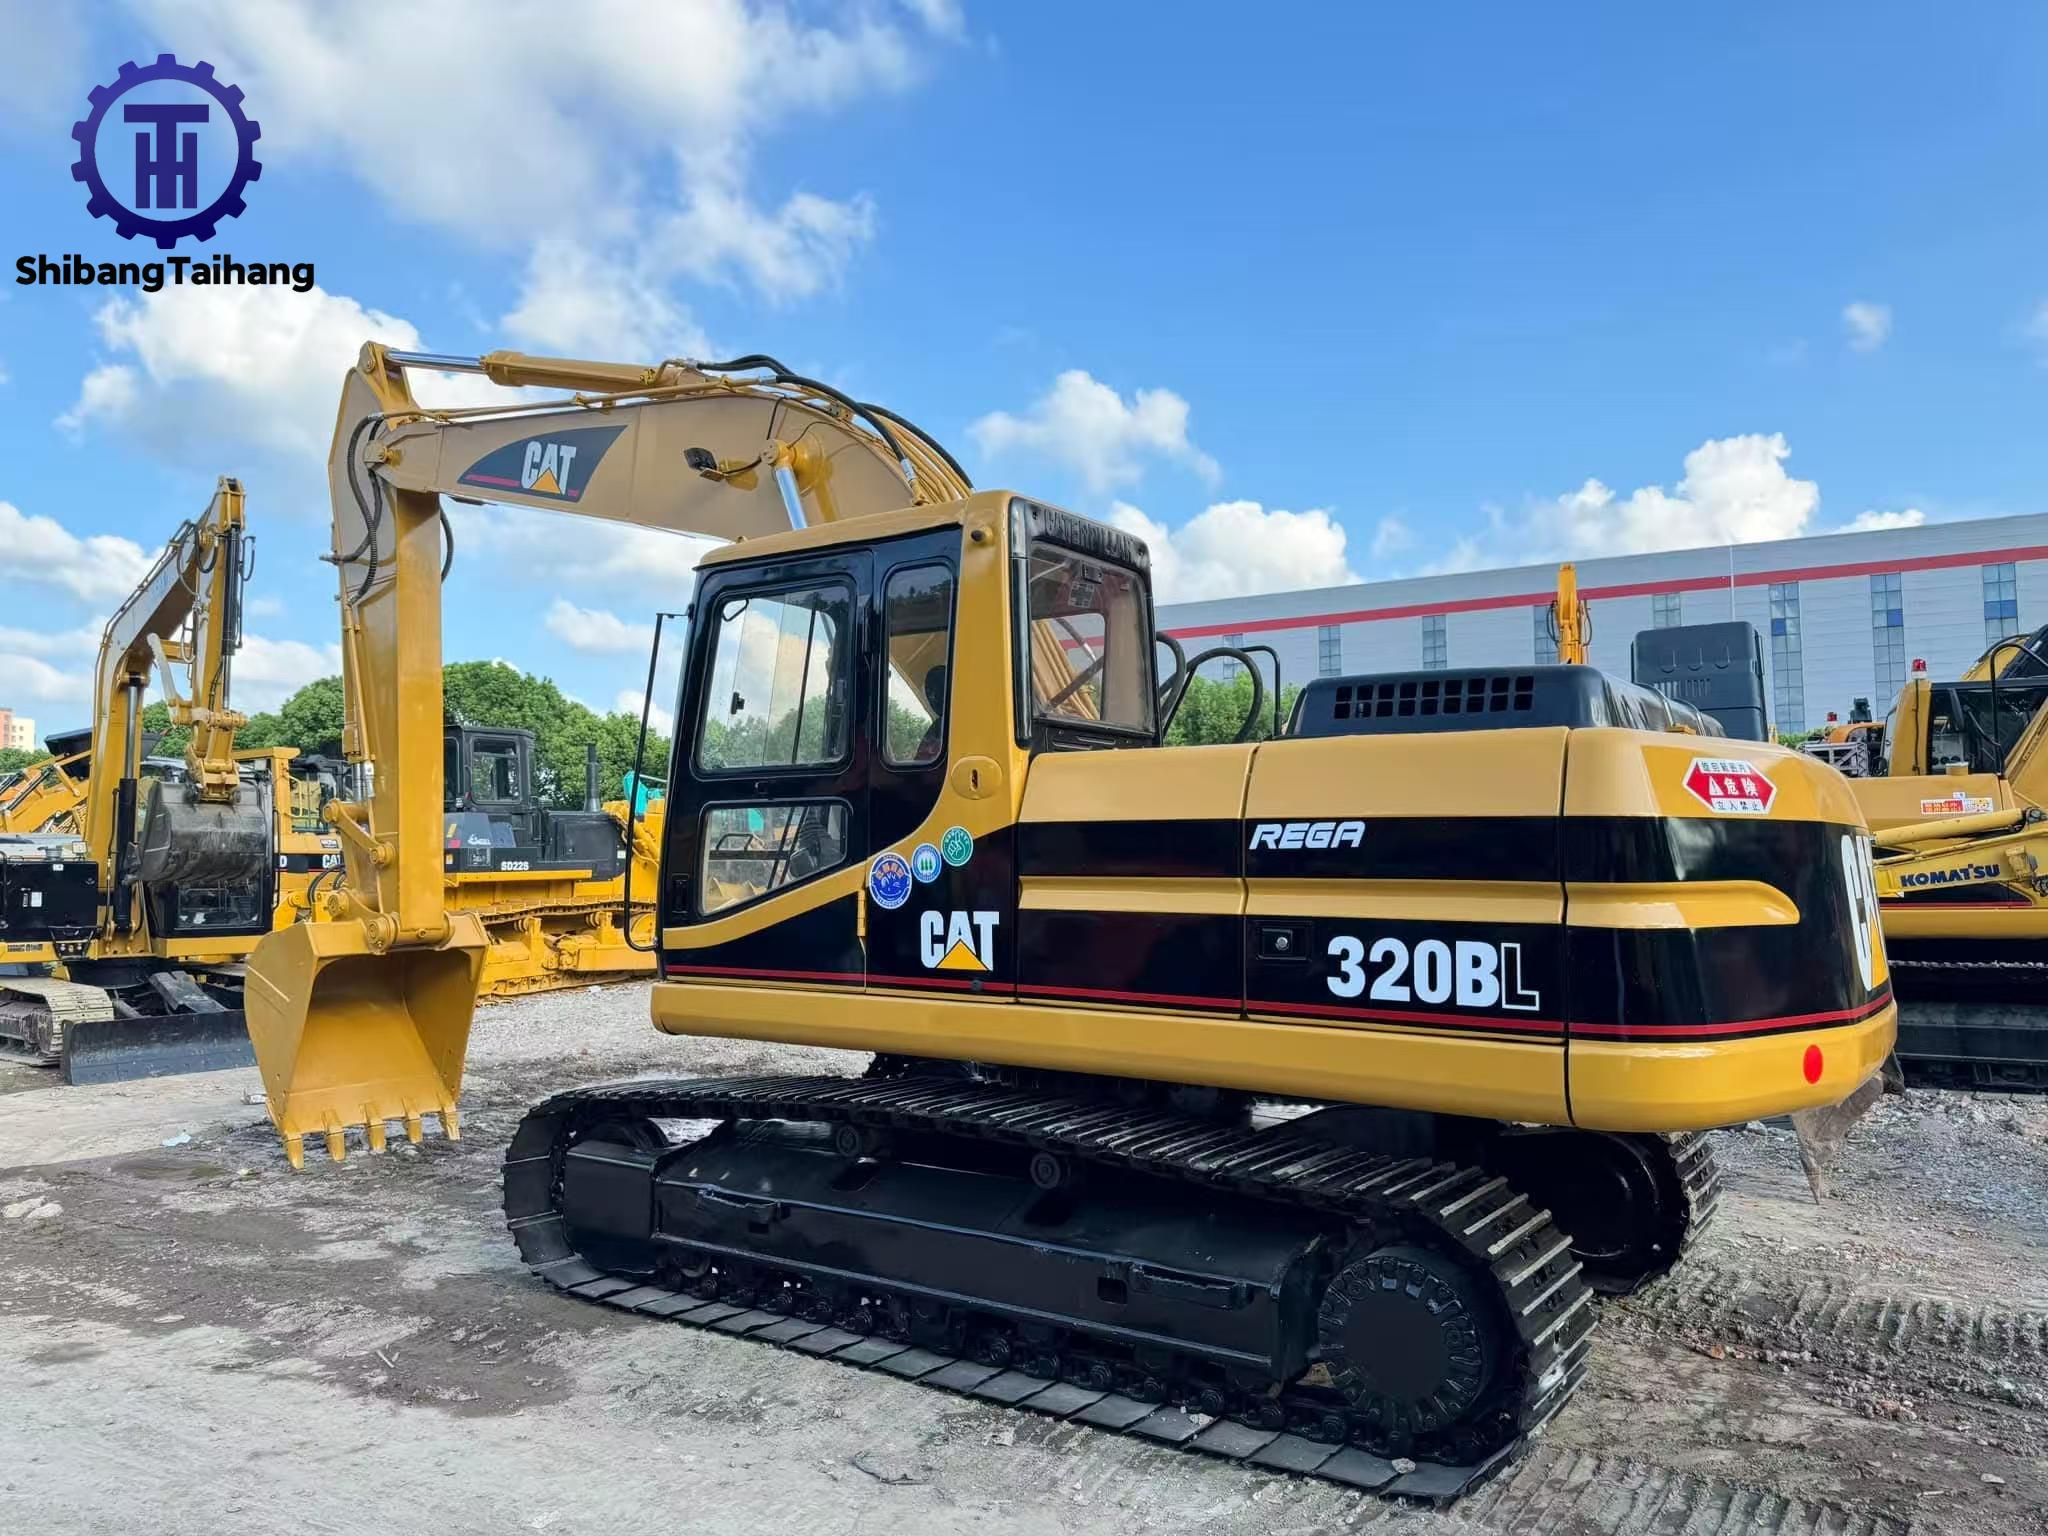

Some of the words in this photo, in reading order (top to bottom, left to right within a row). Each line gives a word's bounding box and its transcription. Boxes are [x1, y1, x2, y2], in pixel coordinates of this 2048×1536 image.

[520, 441, 577, 495] CAT
[1249, 821, 1366, 850] REGA
[1900, 864, 2000, 887] KOMATSU
[920, 910, 1000, 972] CAT
[1326, 935, 1540, 1011] 320BL
